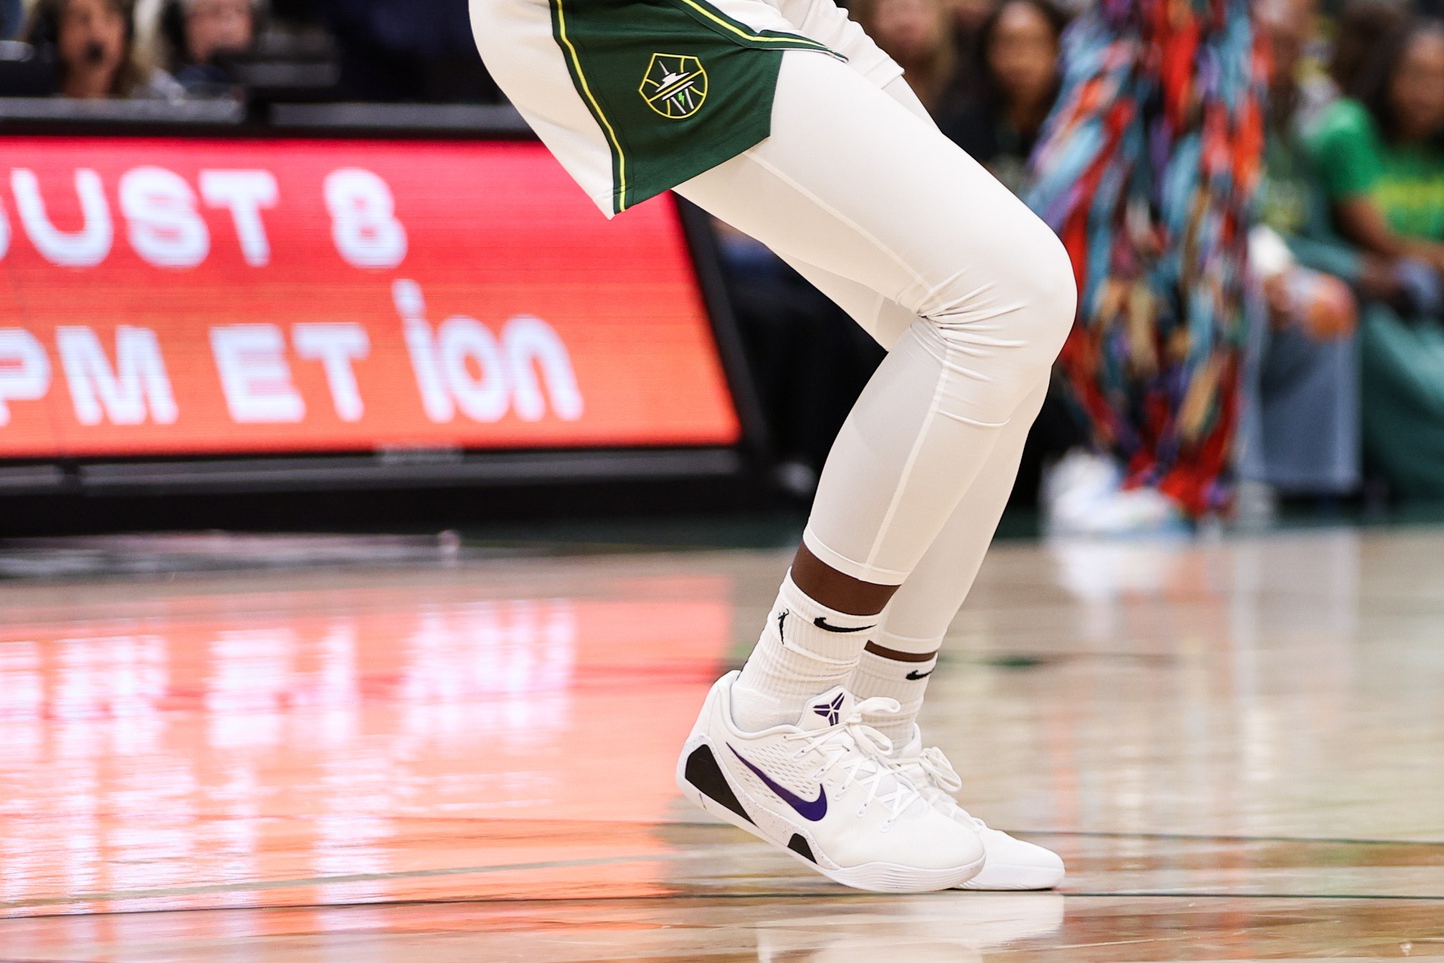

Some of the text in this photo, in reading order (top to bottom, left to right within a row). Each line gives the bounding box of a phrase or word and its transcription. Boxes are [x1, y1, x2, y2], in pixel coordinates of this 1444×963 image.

[0, 165, 409, 269] UST 8
[209, 321, 372, 425] ET
[391, 278, 585, 425] ion
